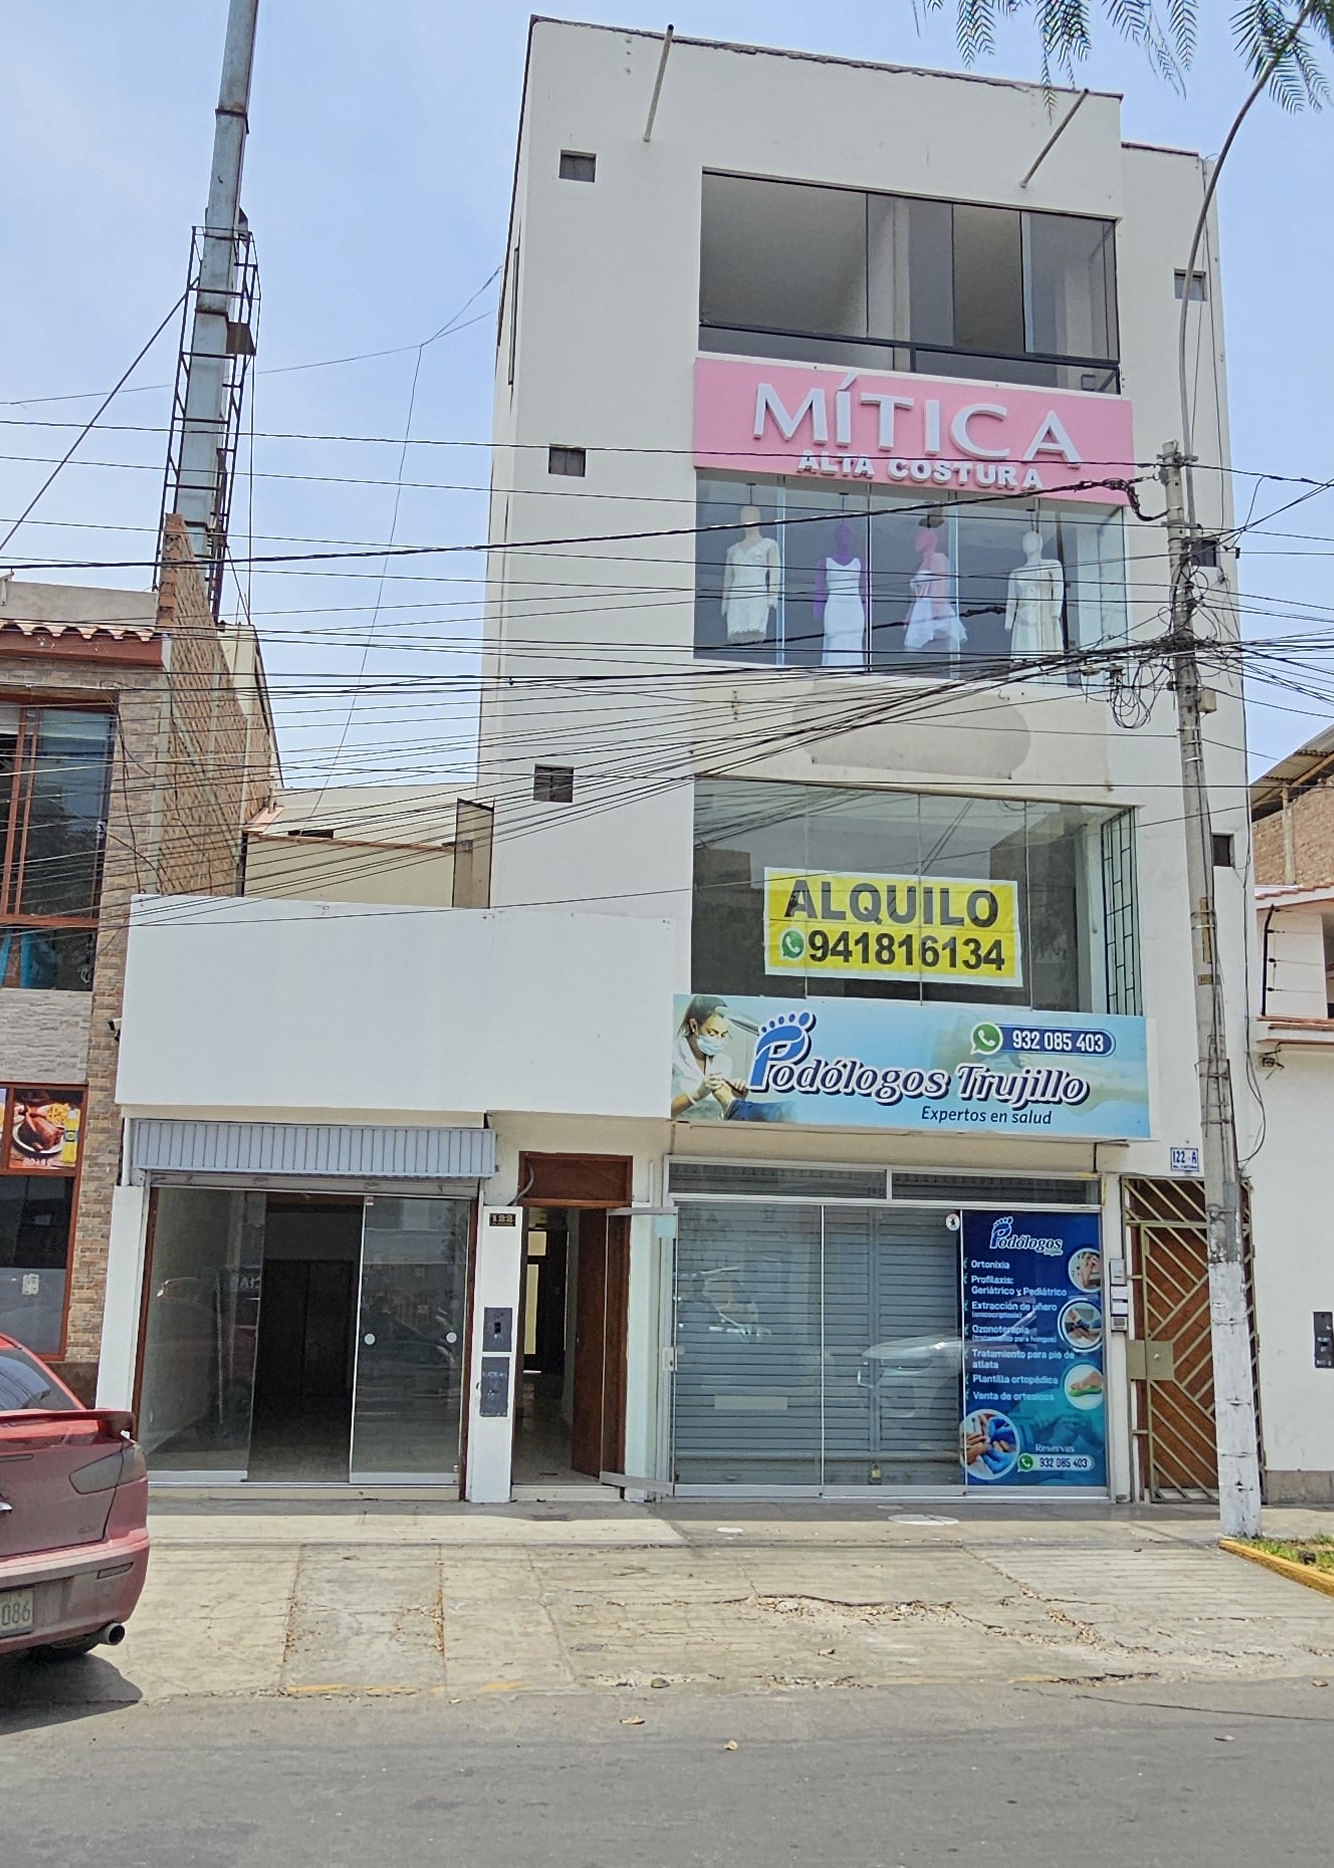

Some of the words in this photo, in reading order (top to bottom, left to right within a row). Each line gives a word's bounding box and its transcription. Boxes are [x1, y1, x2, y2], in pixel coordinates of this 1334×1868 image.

[753, 373, 1082, 469] MÍTICA
[798, 450, 875, 478] ALTA
[887, 456, 1044, 489] COSTURA
[785, 879, 999, 928] ALQUILO
[808, 930, 1005, 971] 941816134
[1012, 1031, 1039, 1048] 932
[1044, 1032, 1072, 1050] 085
[1076, 1034, 1104, 1052] 403
[748, 1010, 951, 1105] Podólogos
[958, 1063, 1090, 1108] Trujillo
[922, 1106, 986, 1123] Expertos
[991, 1111, 1008, 1123] en
[1011, 1107, 1052, 1125] salud
[492, 1214, 514, 1223] 122
[989, 1216, 1064, 1253] Podólogos
[971, 1260, 1010, 1269] Ortonixia
[971, 1286, 1014, 1295] Geriátrico
[1023, 1287, 1067, 1296] Pediátrico
[972, 1301, 1018, 1311] Extracción
[972, 1349, 1026, 1358] Tratamiento
[1027, 1351, 1047, 1360] para
[1064, 1351, 1075, 1359] de
[972, 1374, 1009, 1383] Plantilla
[1011, 1375, 1058, 1385] ortopédica
[973, 1391, 998, 1400] Venta
[1000, 1392, 1011, 1400] de
[1035, 1444, 1075, 1453] Reservas
[1040, 1457, 1054, 1468] 932
